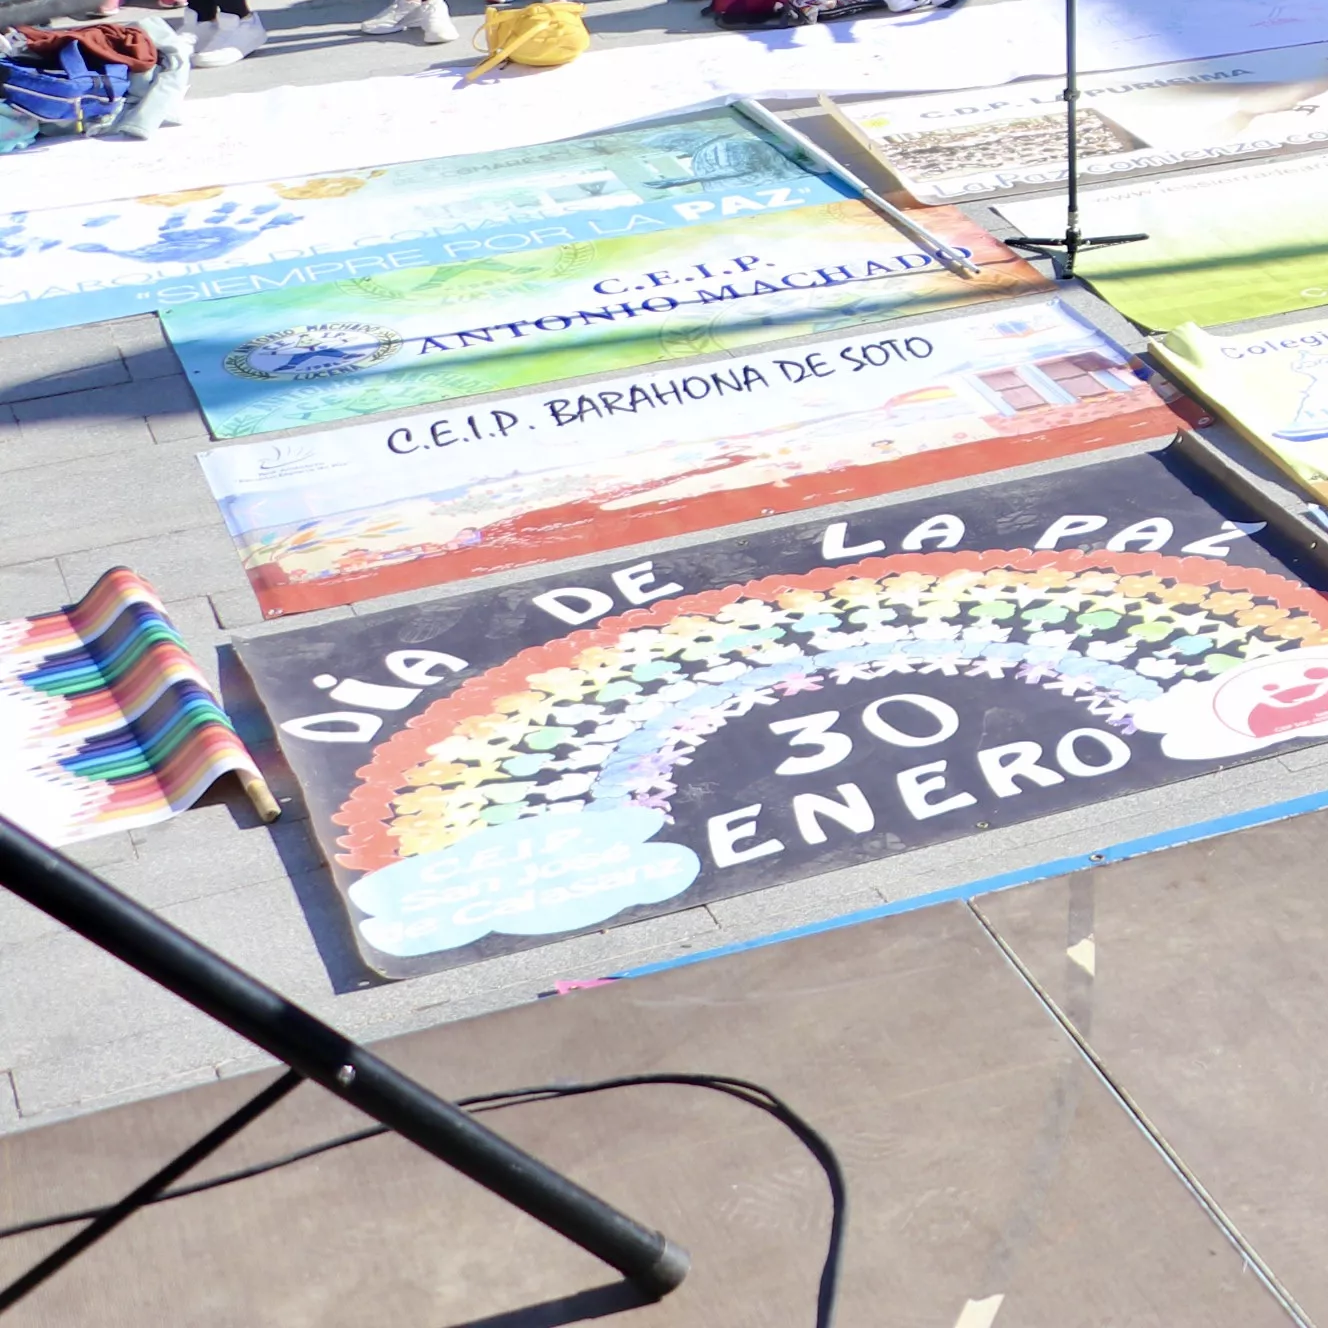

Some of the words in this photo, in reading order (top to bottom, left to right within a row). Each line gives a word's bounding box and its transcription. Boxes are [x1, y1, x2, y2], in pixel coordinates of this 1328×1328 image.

[919, 100, 1023, 120] C.D.P.
[1088, 66, 1256, 98] PURÍSIMA
[932, 178, 987, 198] La
[1087, 136, 1281, 176] comienza
[441, 224, 574, 259] POR
[583, 212, 664, 236] LA
[592, 253, 777, 296] C.E.I.P.
[415, 299, 679, 357] ANTONIO
[696, 245, 974, 302] MACHADO
[387, 409, 537, 455] C.E.I.P.
[544, 366, 769, 428] BARAHONA
[774, 352, 837, 384] DE
[839, 335, 935, 373] SOTO
[531, 558, 685, 628] DE
[818, 510, 971, 562] LA
[1035, 512, 1268, 561] PAZ
[768, 691, 961, 778] 30
[706, 725, 1133, 871] ENERO
